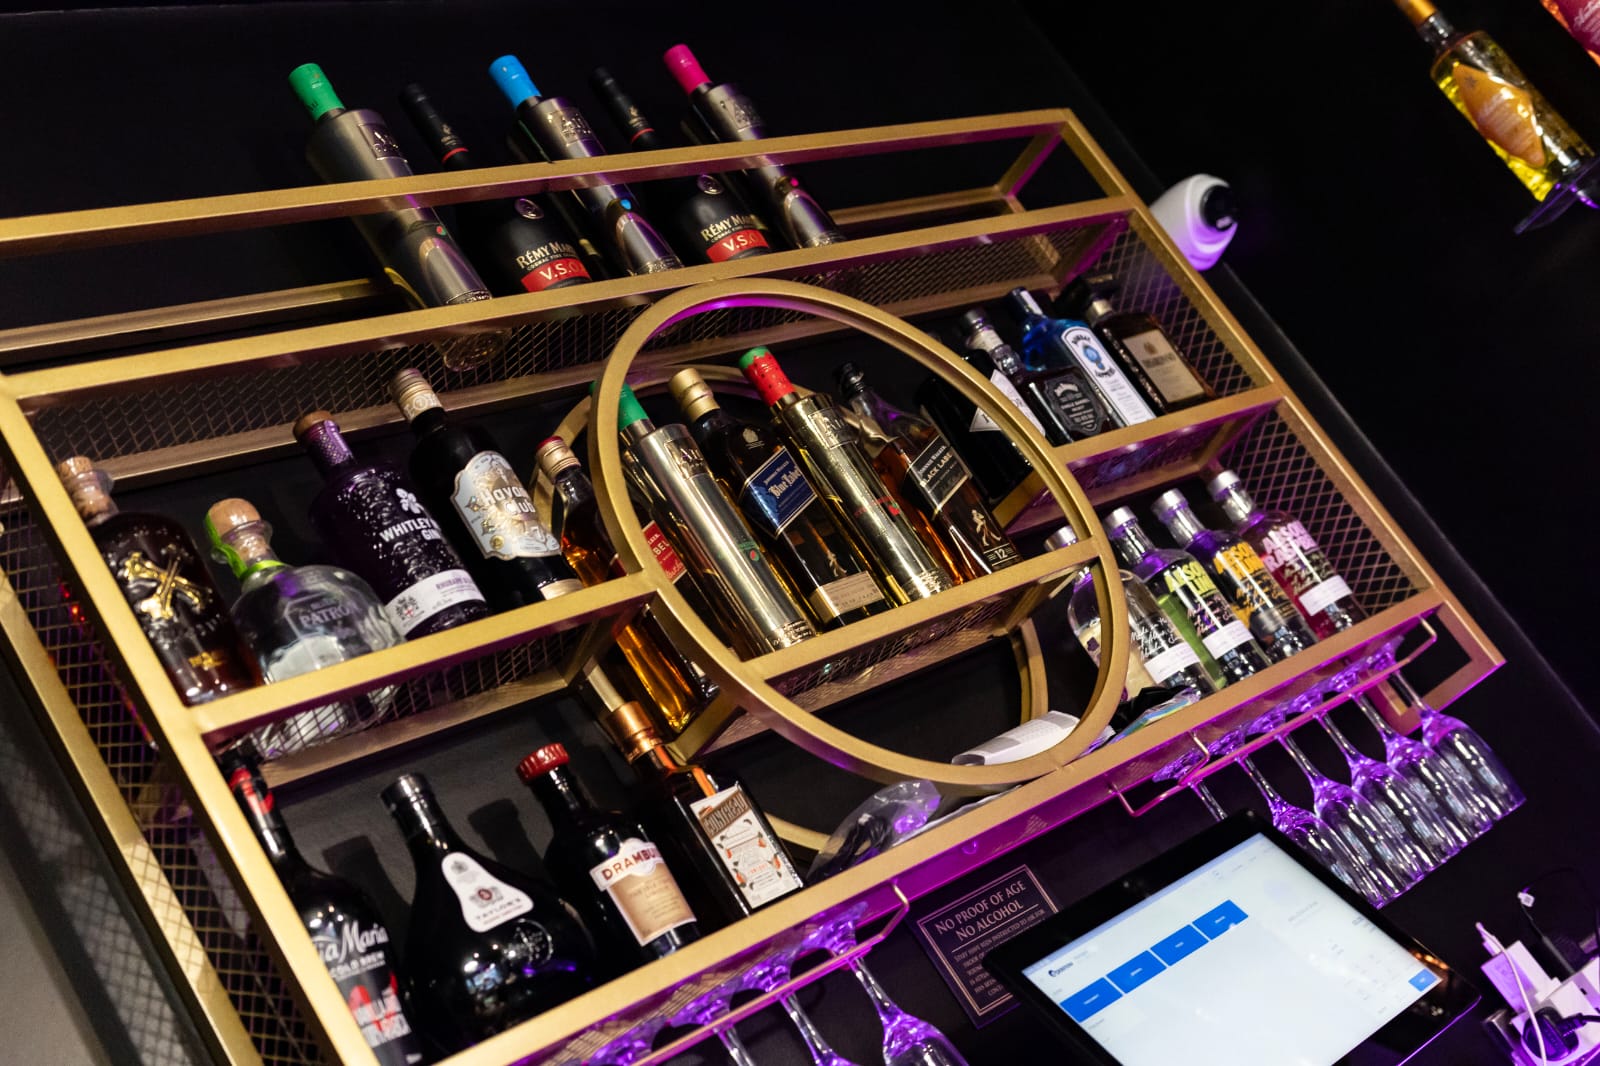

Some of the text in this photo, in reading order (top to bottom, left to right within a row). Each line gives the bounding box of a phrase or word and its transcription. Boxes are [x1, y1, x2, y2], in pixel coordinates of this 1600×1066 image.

[700, 218, 732, 242] RÉMY
[515, 245, 550, 269] RÉMY
[379, 517, 433, 543] WHITLEY
[994, 548, 1008, 559] 12
[934, 880, 1027, 935] NO PROOF OF AGE
[955, 899, 1024, 941] NO ALCOHOL
